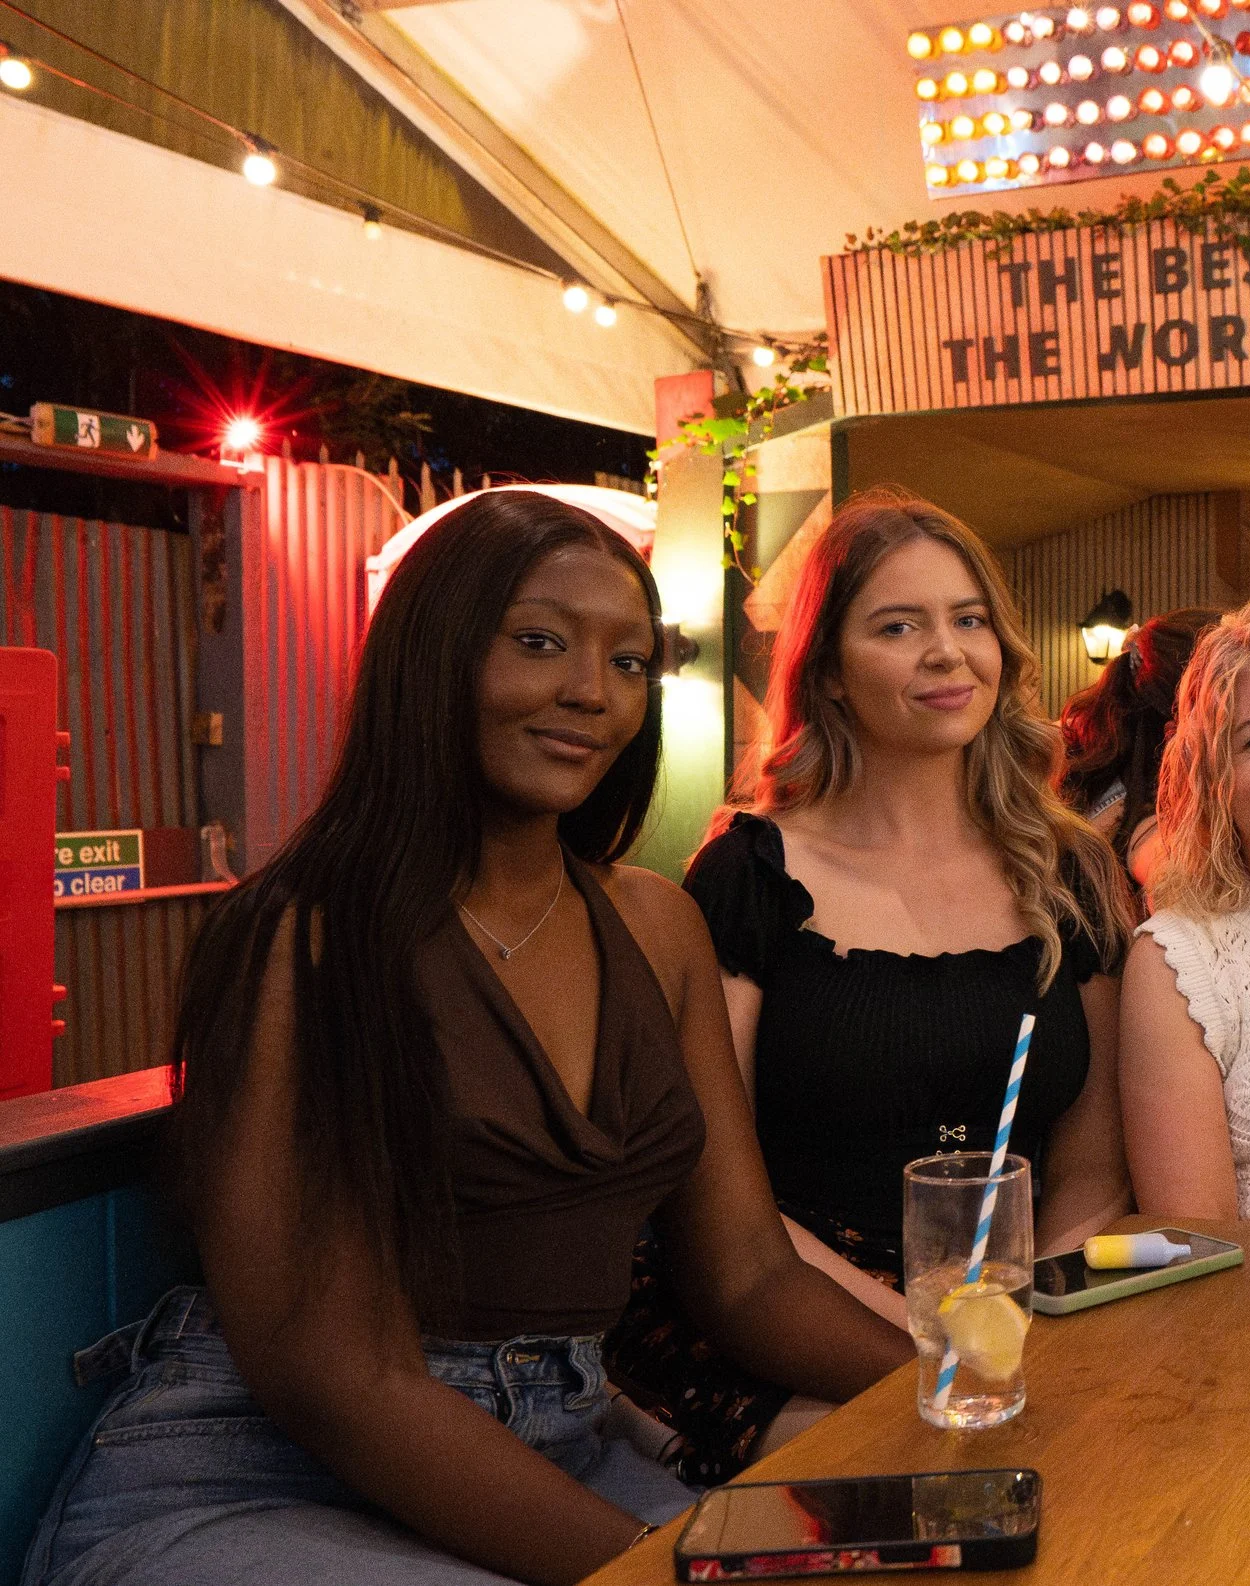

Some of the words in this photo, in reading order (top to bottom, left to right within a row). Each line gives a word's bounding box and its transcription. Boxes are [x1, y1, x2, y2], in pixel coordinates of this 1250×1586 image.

[1000, 253, 1121, 308] THE
[942, 331, 1061, 383] THE
[80, 840, 120, 864] exit
[70, 873, 125, 895] clear
